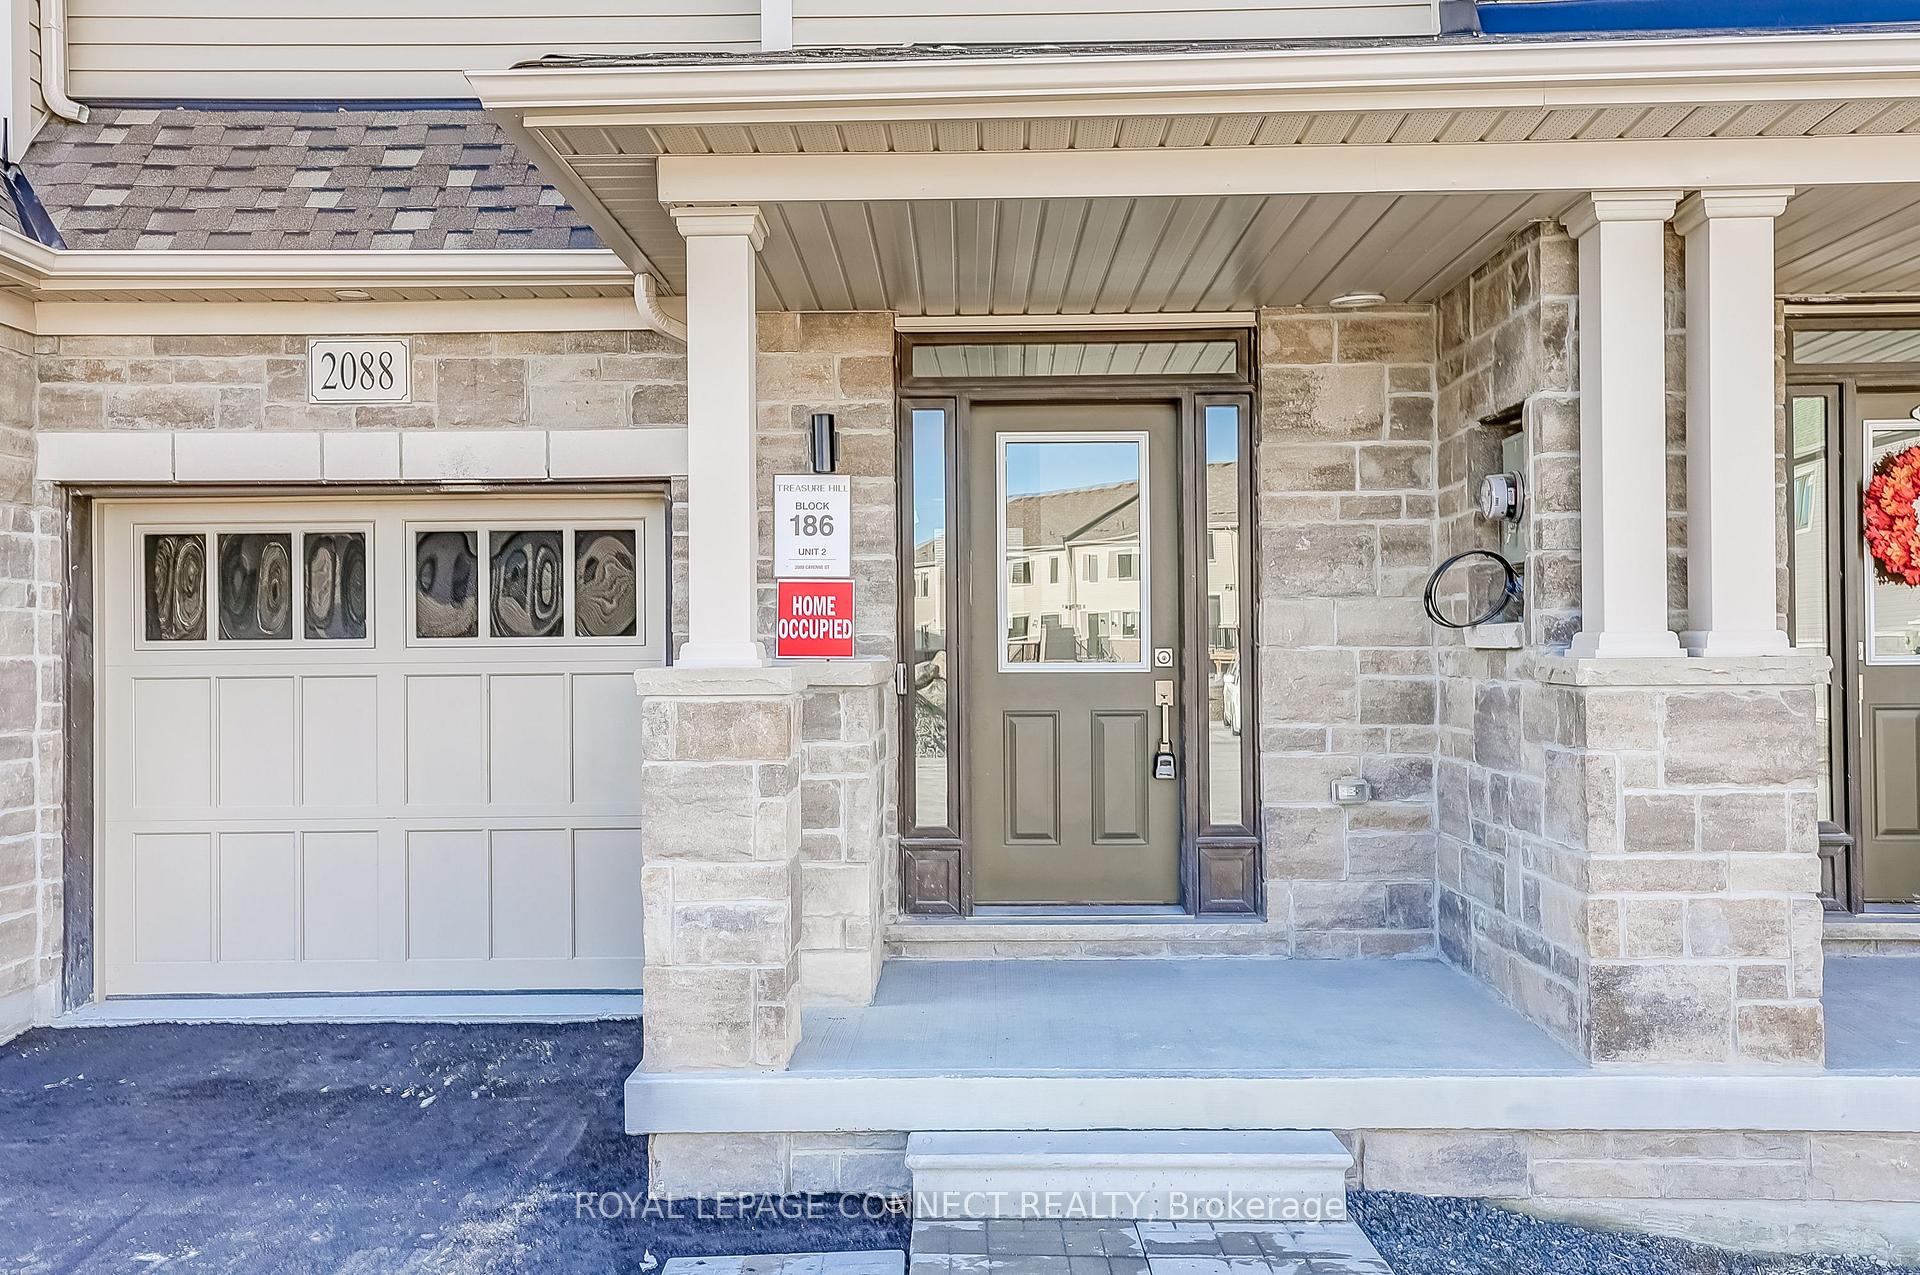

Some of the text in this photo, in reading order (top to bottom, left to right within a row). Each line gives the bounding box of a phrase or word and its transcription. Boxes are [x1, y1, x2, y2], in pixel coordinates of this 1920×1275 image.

[320, 351, 394, 391] 2088
[776, 484, 848, 493] TREASURE HILL
[795, 501, 830, 511] BLOCK
[789, 514, 834, 537] 186
[798, 547, 827, 556] UNIT 2
[792, 596, 836, 616] HOME
[778, 618, 852, 640] OCCUPIED
